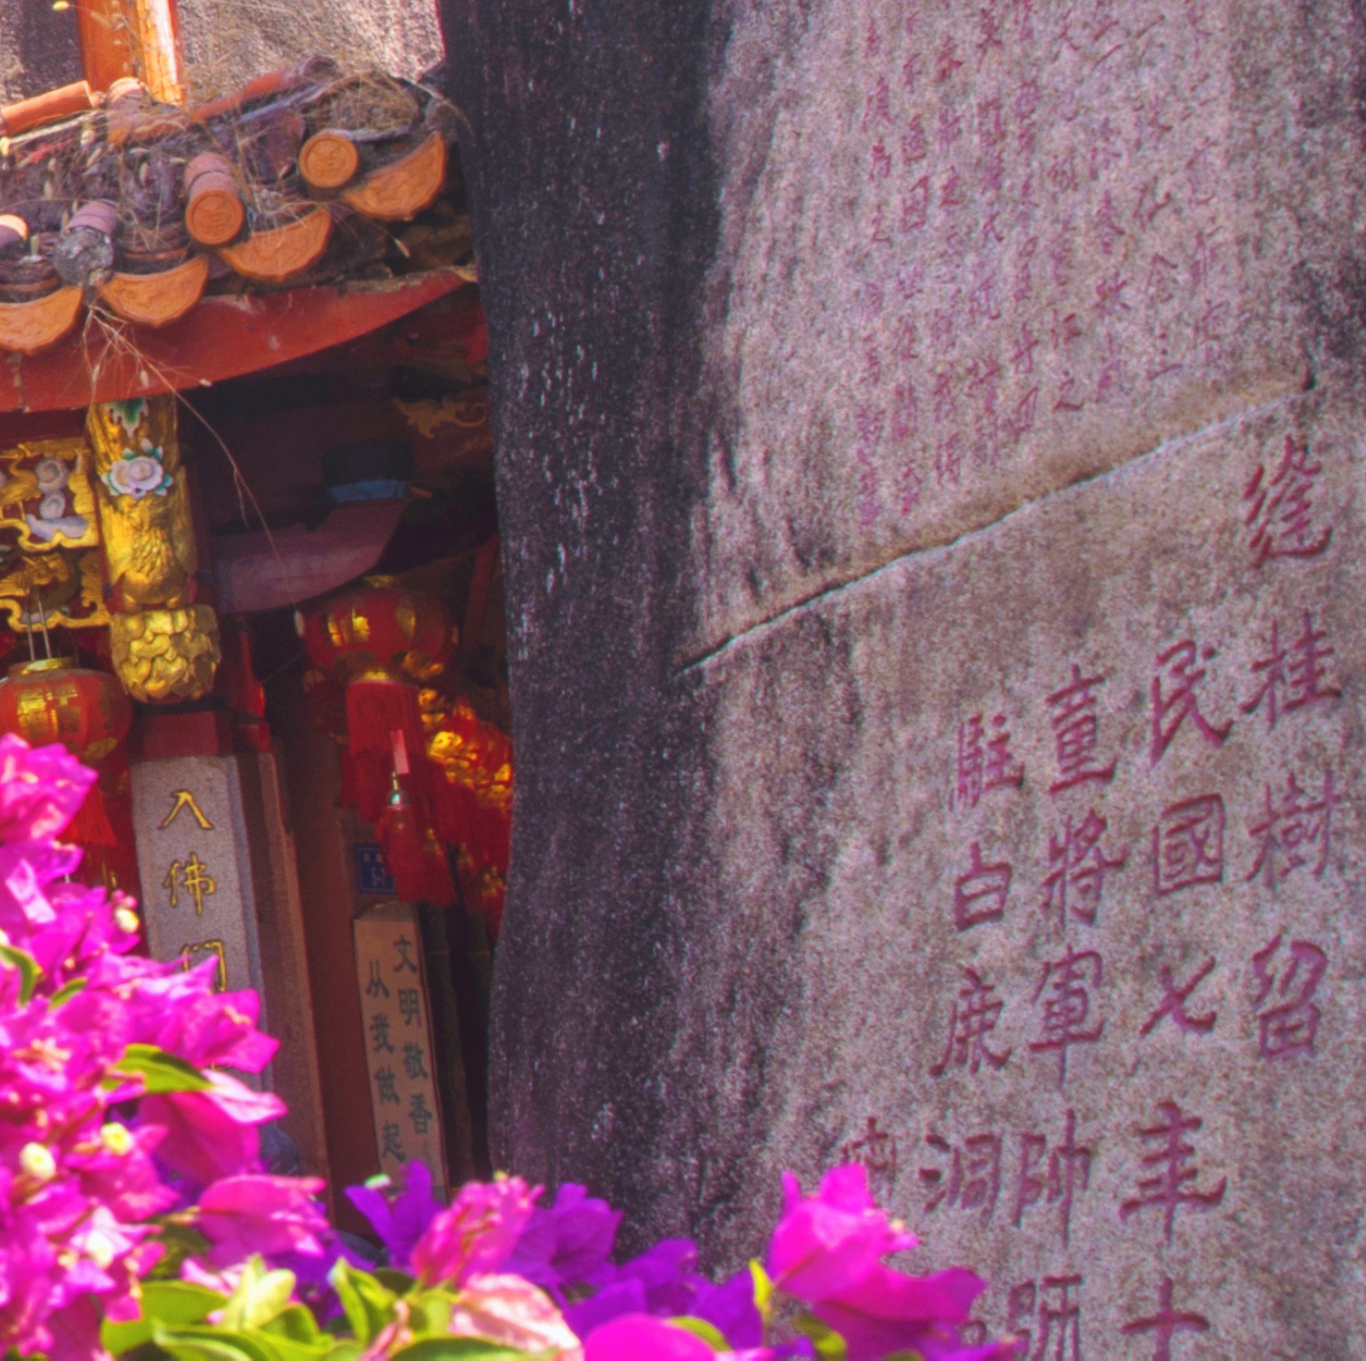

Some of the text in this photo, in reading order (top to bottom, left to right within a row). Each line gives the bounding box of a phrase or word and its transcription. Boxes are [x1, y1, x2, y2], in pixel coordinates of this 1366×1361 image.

[365, 958, 407, 1163] 从我做起
[393, 934, 434, 1135] 文明敬香
[918, 710, 1027, 1346] 駐白鹿洞
